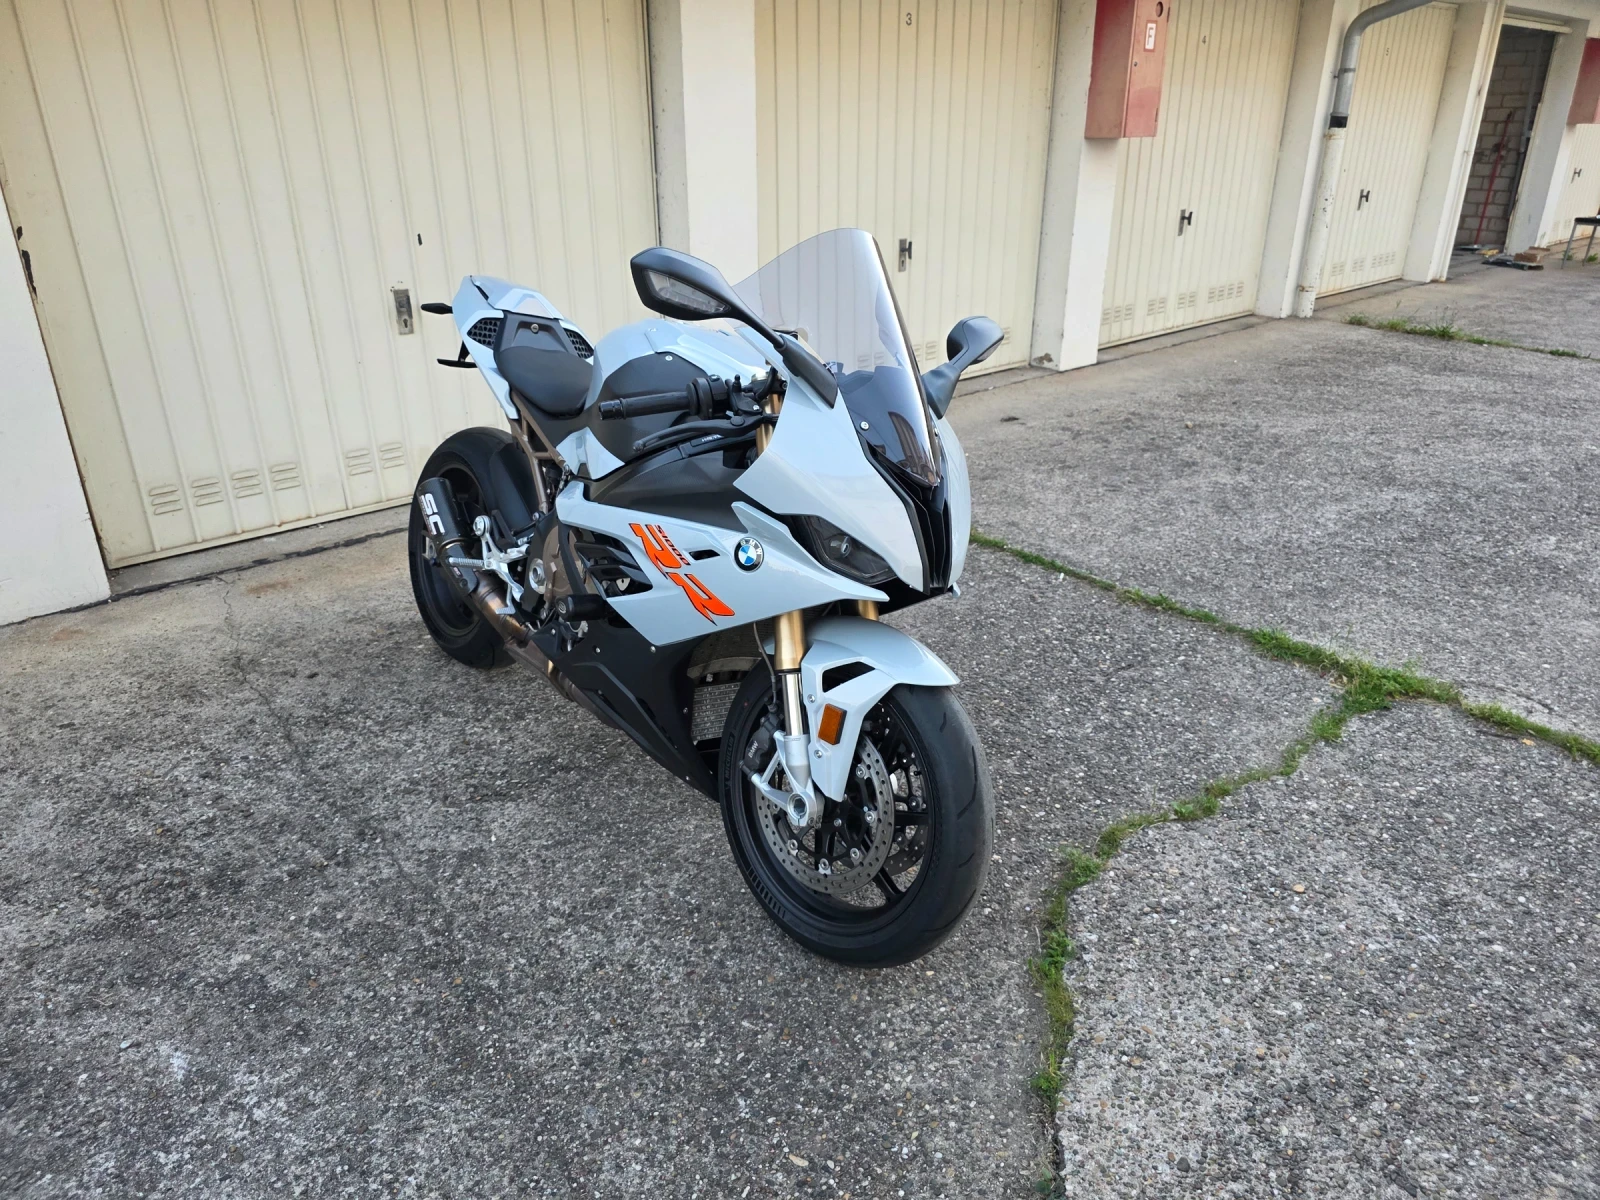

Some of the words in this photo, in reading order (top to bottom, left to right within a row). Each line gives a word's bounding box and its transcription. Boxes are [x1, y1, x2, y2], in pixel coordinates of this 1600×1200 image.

[905, 13, 913, 26] 3
[1146, 26, 1155, 46] F
[1201, 35, 1207, 45] 4
[420, 493, 445, 536] SC
[655, 524, 691, 566] S1000
[748, 740, 759, 759] BMW
